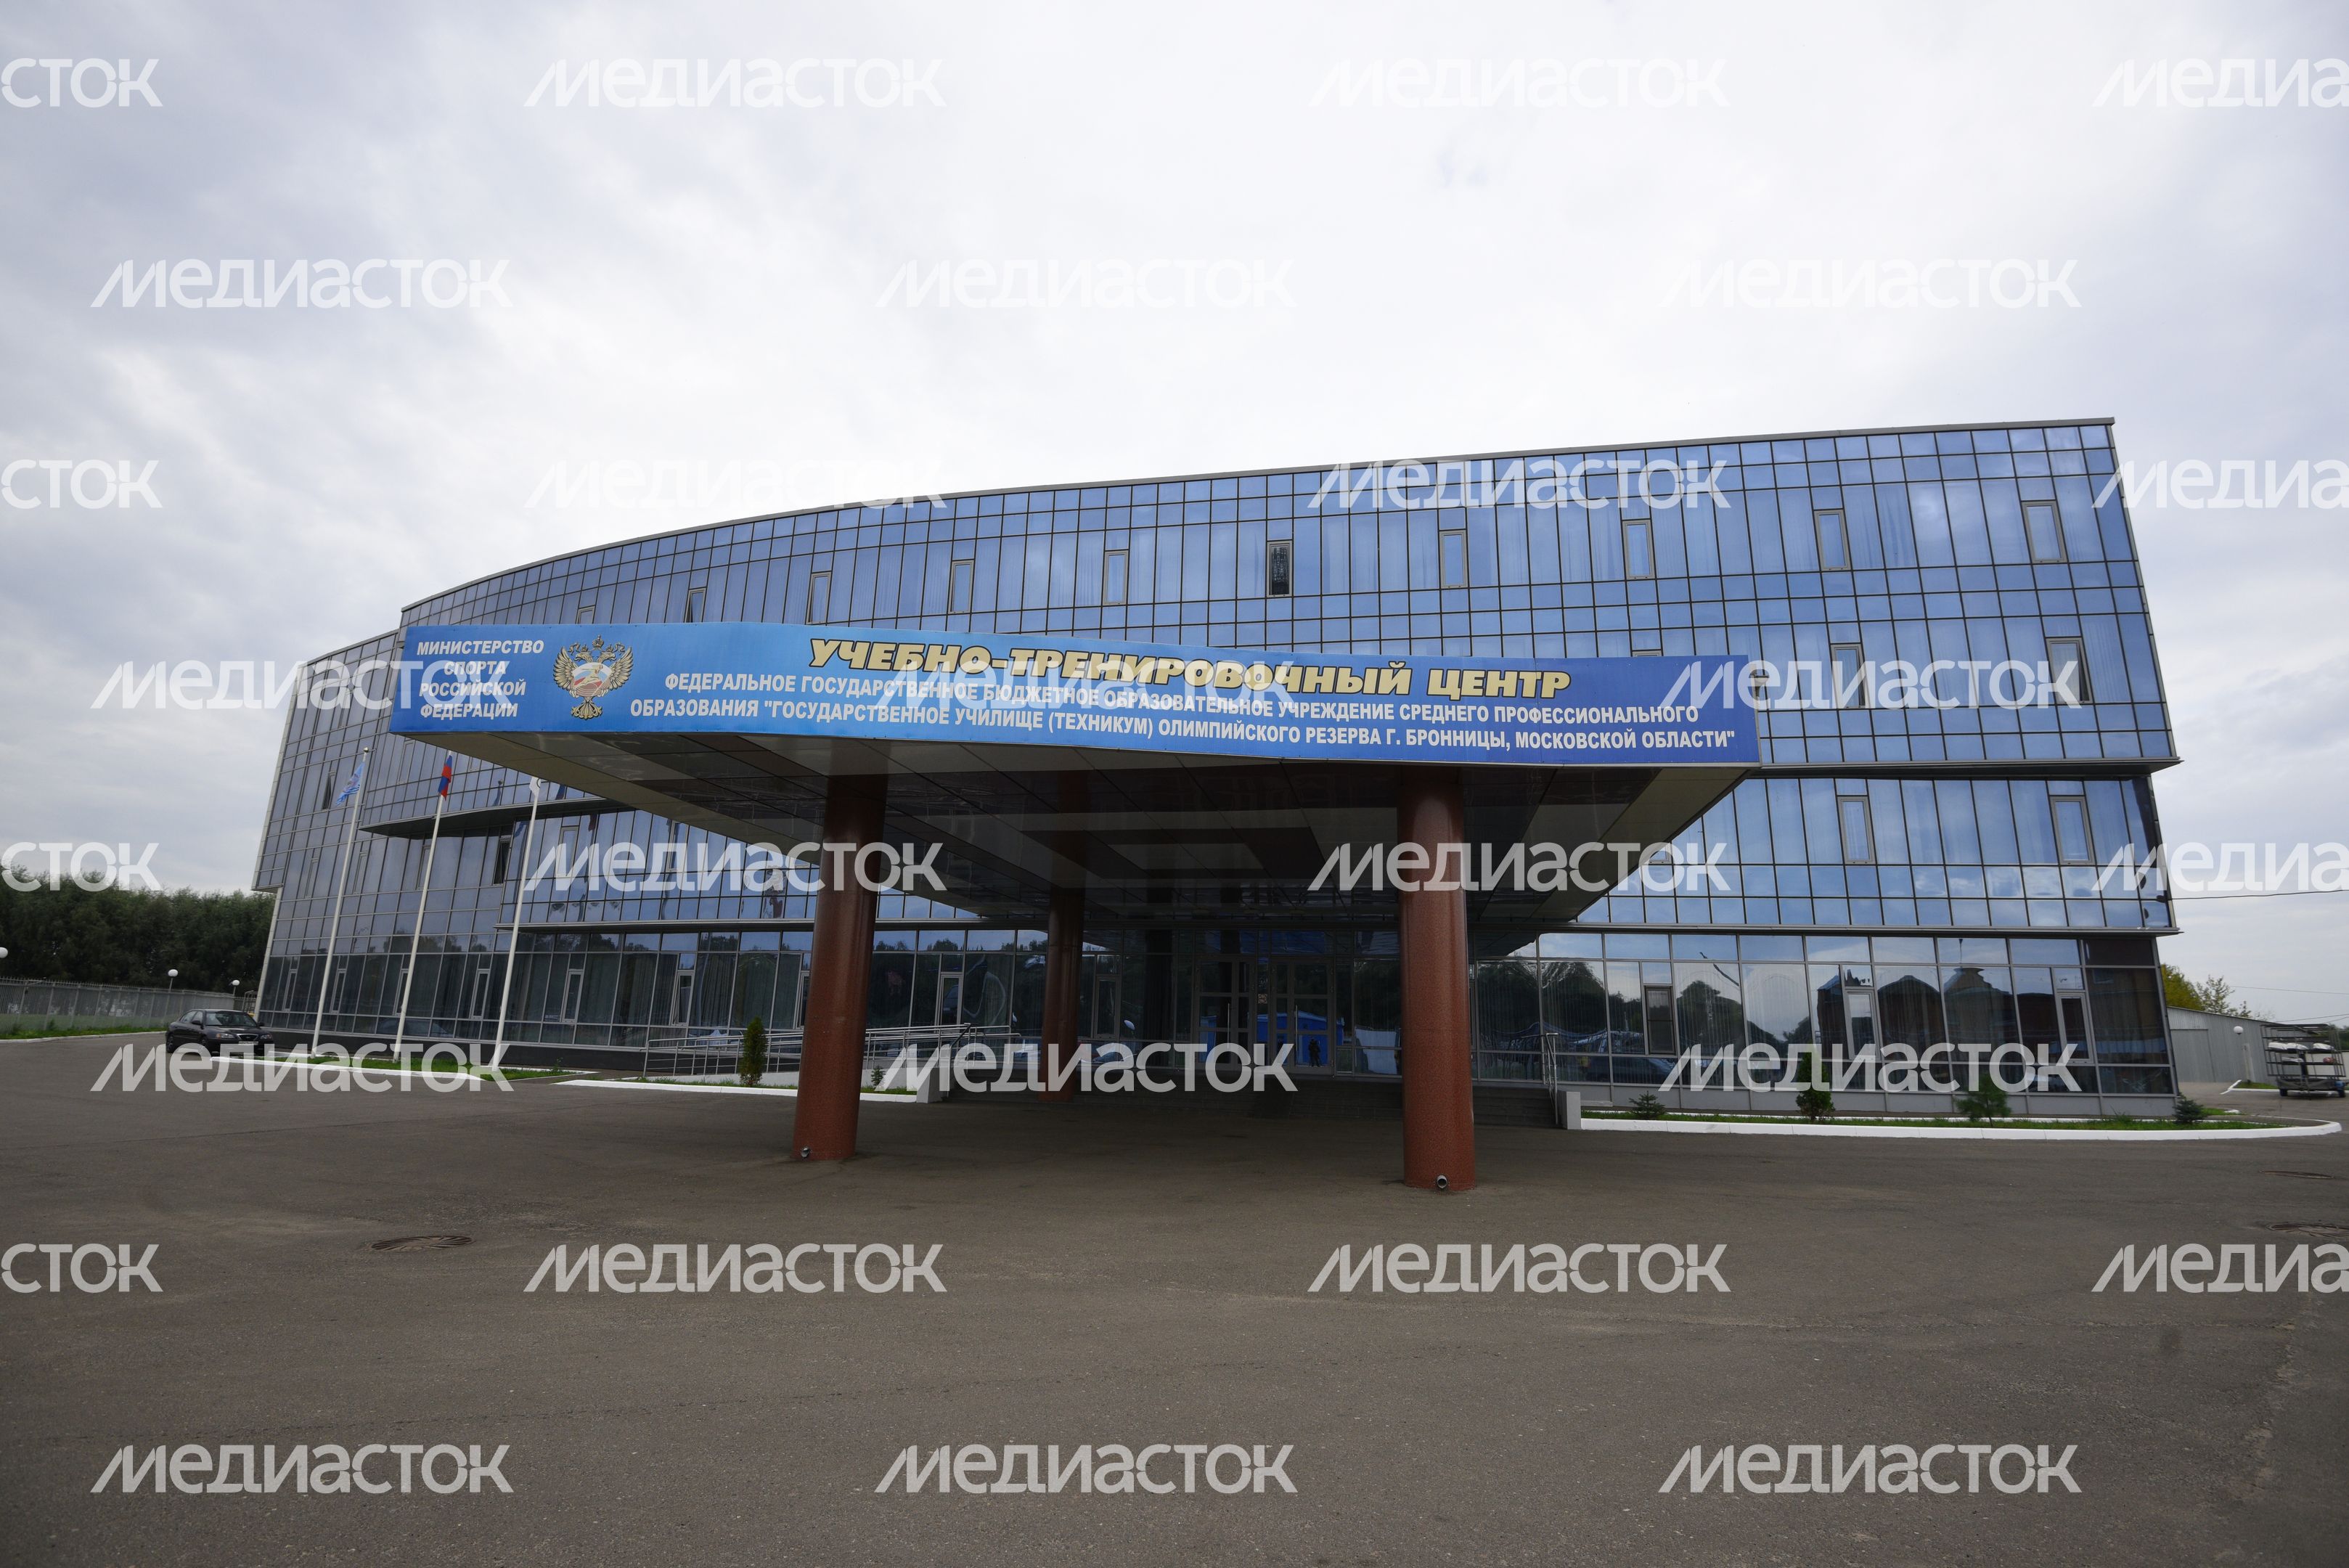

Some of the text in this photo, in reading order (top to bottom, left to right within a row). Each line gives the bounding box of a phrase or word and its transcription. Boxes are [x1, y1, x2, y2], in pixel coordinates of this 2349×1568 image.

[417, 640, 544, 655] МИНИСТЕРСТВО
[444, 661, 506, 675] СПОРТА
[809, 639, 1571, 701] УЧЕБНО-ТРЕНИРОВОЧНЫЙ ЦЕНТР
[419, 679, 526, 696] РОССИЙСКОЙ
[665, 673, 1699, 724] ФЕДЕРАЛЬНОЕ ГОСУДАРСТВЕННОЕ БЮДЖЕТНОЕ ОБРАЗОВАТЕЛЬНОЕ УЧРЕЖДЕНИЕ СРЕДНЕГО ПРОФЕССИОНАЛЬНОГО
[420, 703, 518, 720] ФЕДЕРАЦИИ
[630, 699, 1735, 751] ОБРАЗОВАНИЯ "ГОСУДАРСТВЕННОЕ УЧИЛИЩЕ (ТЕХНИКУМ) ОЛИМПИЙСКОГО РЕЗЕРВА Г. БРОННИЦЫ, МОСКОВСКОЙ ОБЛАСТИ"
